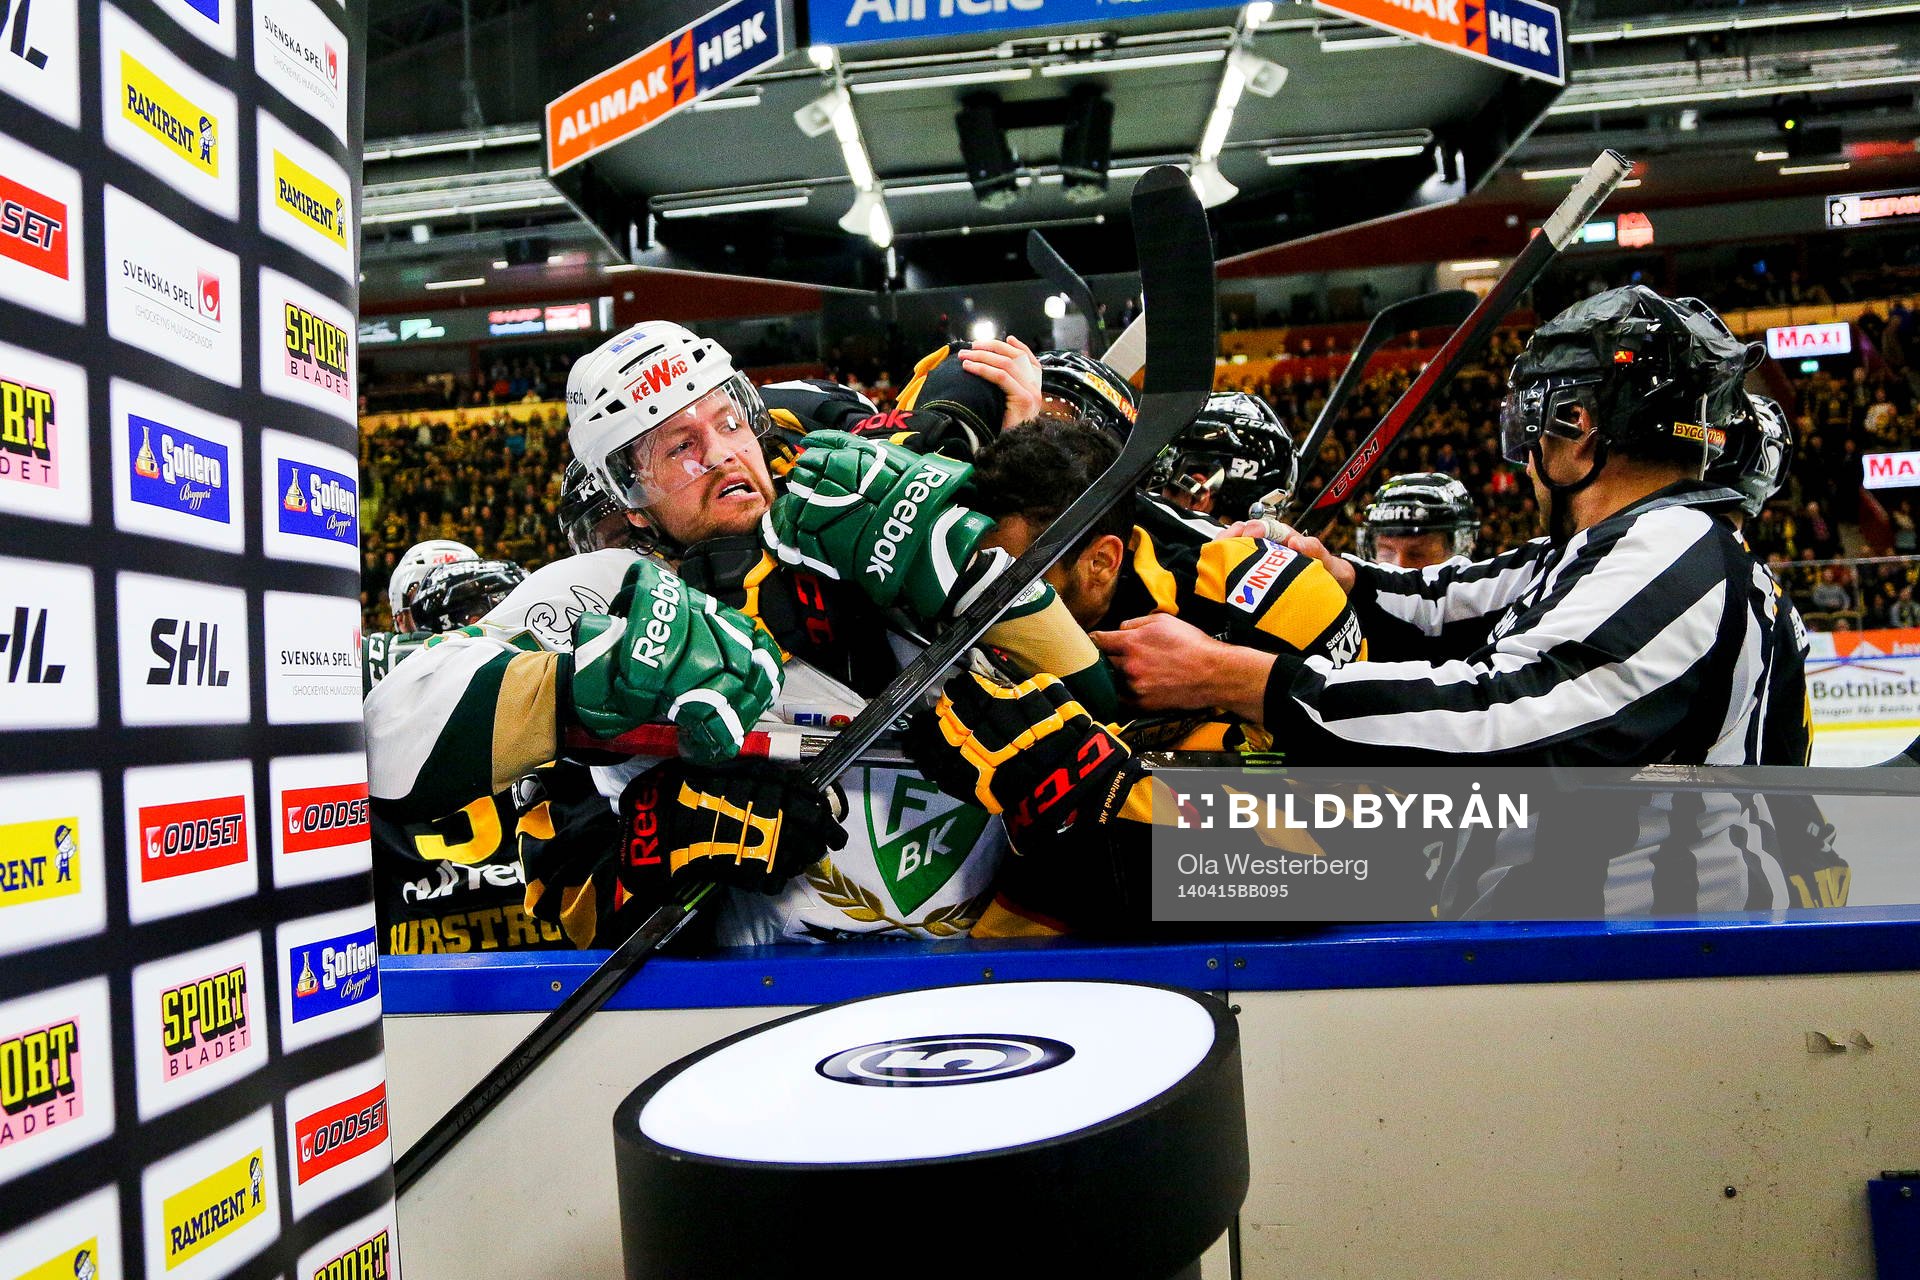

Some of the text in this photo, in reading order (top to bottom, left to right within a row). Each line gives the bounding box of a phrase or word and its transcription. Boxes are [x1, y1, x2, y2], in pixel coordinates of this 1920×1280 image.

[264, 15, 324, 73] SVENSKA SPEL
[1489, 10, 1551, 57] HEK
[558, 11, 769, 147] ALIMAK HEK
[127, 84, 195, 154] RAMIRENT
[0, 202, 62, 251] SET
[279, 177, 334, 232] RAMIRENT
[122, 259, 195, 310] SVENSKA SPEL
[285, 302, 349, 380] SPORT
[290, 360, 350, 396] BLADET
[0, 459, 52, 484] DET
[162, 434, 223, 488] Sofiero
[1331, 437, 1380, 498] CCM
[1869, 457, 1920, 477] MA
[179, 481, 212, 511] Bryggeri
[865, 463, 952, 583] Reebok
[631, 563, 683, 669] Reebo
[0, 607, 66, 683] HL
[146, 617, 230, 687] SHL
[281, 650, 352, 667] SVENSKA SPEL
[1813, 677, 1920, 700] Botniast
[163, 812, 243, 858] ODDSET
[629, 785, 663, 867] Ree
[896, 816, 953, 882] BK
[0, 855, 47, 893] RENT
[162, 967, 248, 1056] SPORT
[0, 1021, 78, 1116] ORT
[169, 1028, 248, 1077] BLADET
[0, 1097, 77, 1145] ADET
[313, 1098, 387, 1157] ODDSET
[171, 1188, 248, 1256] RAMIRENT
